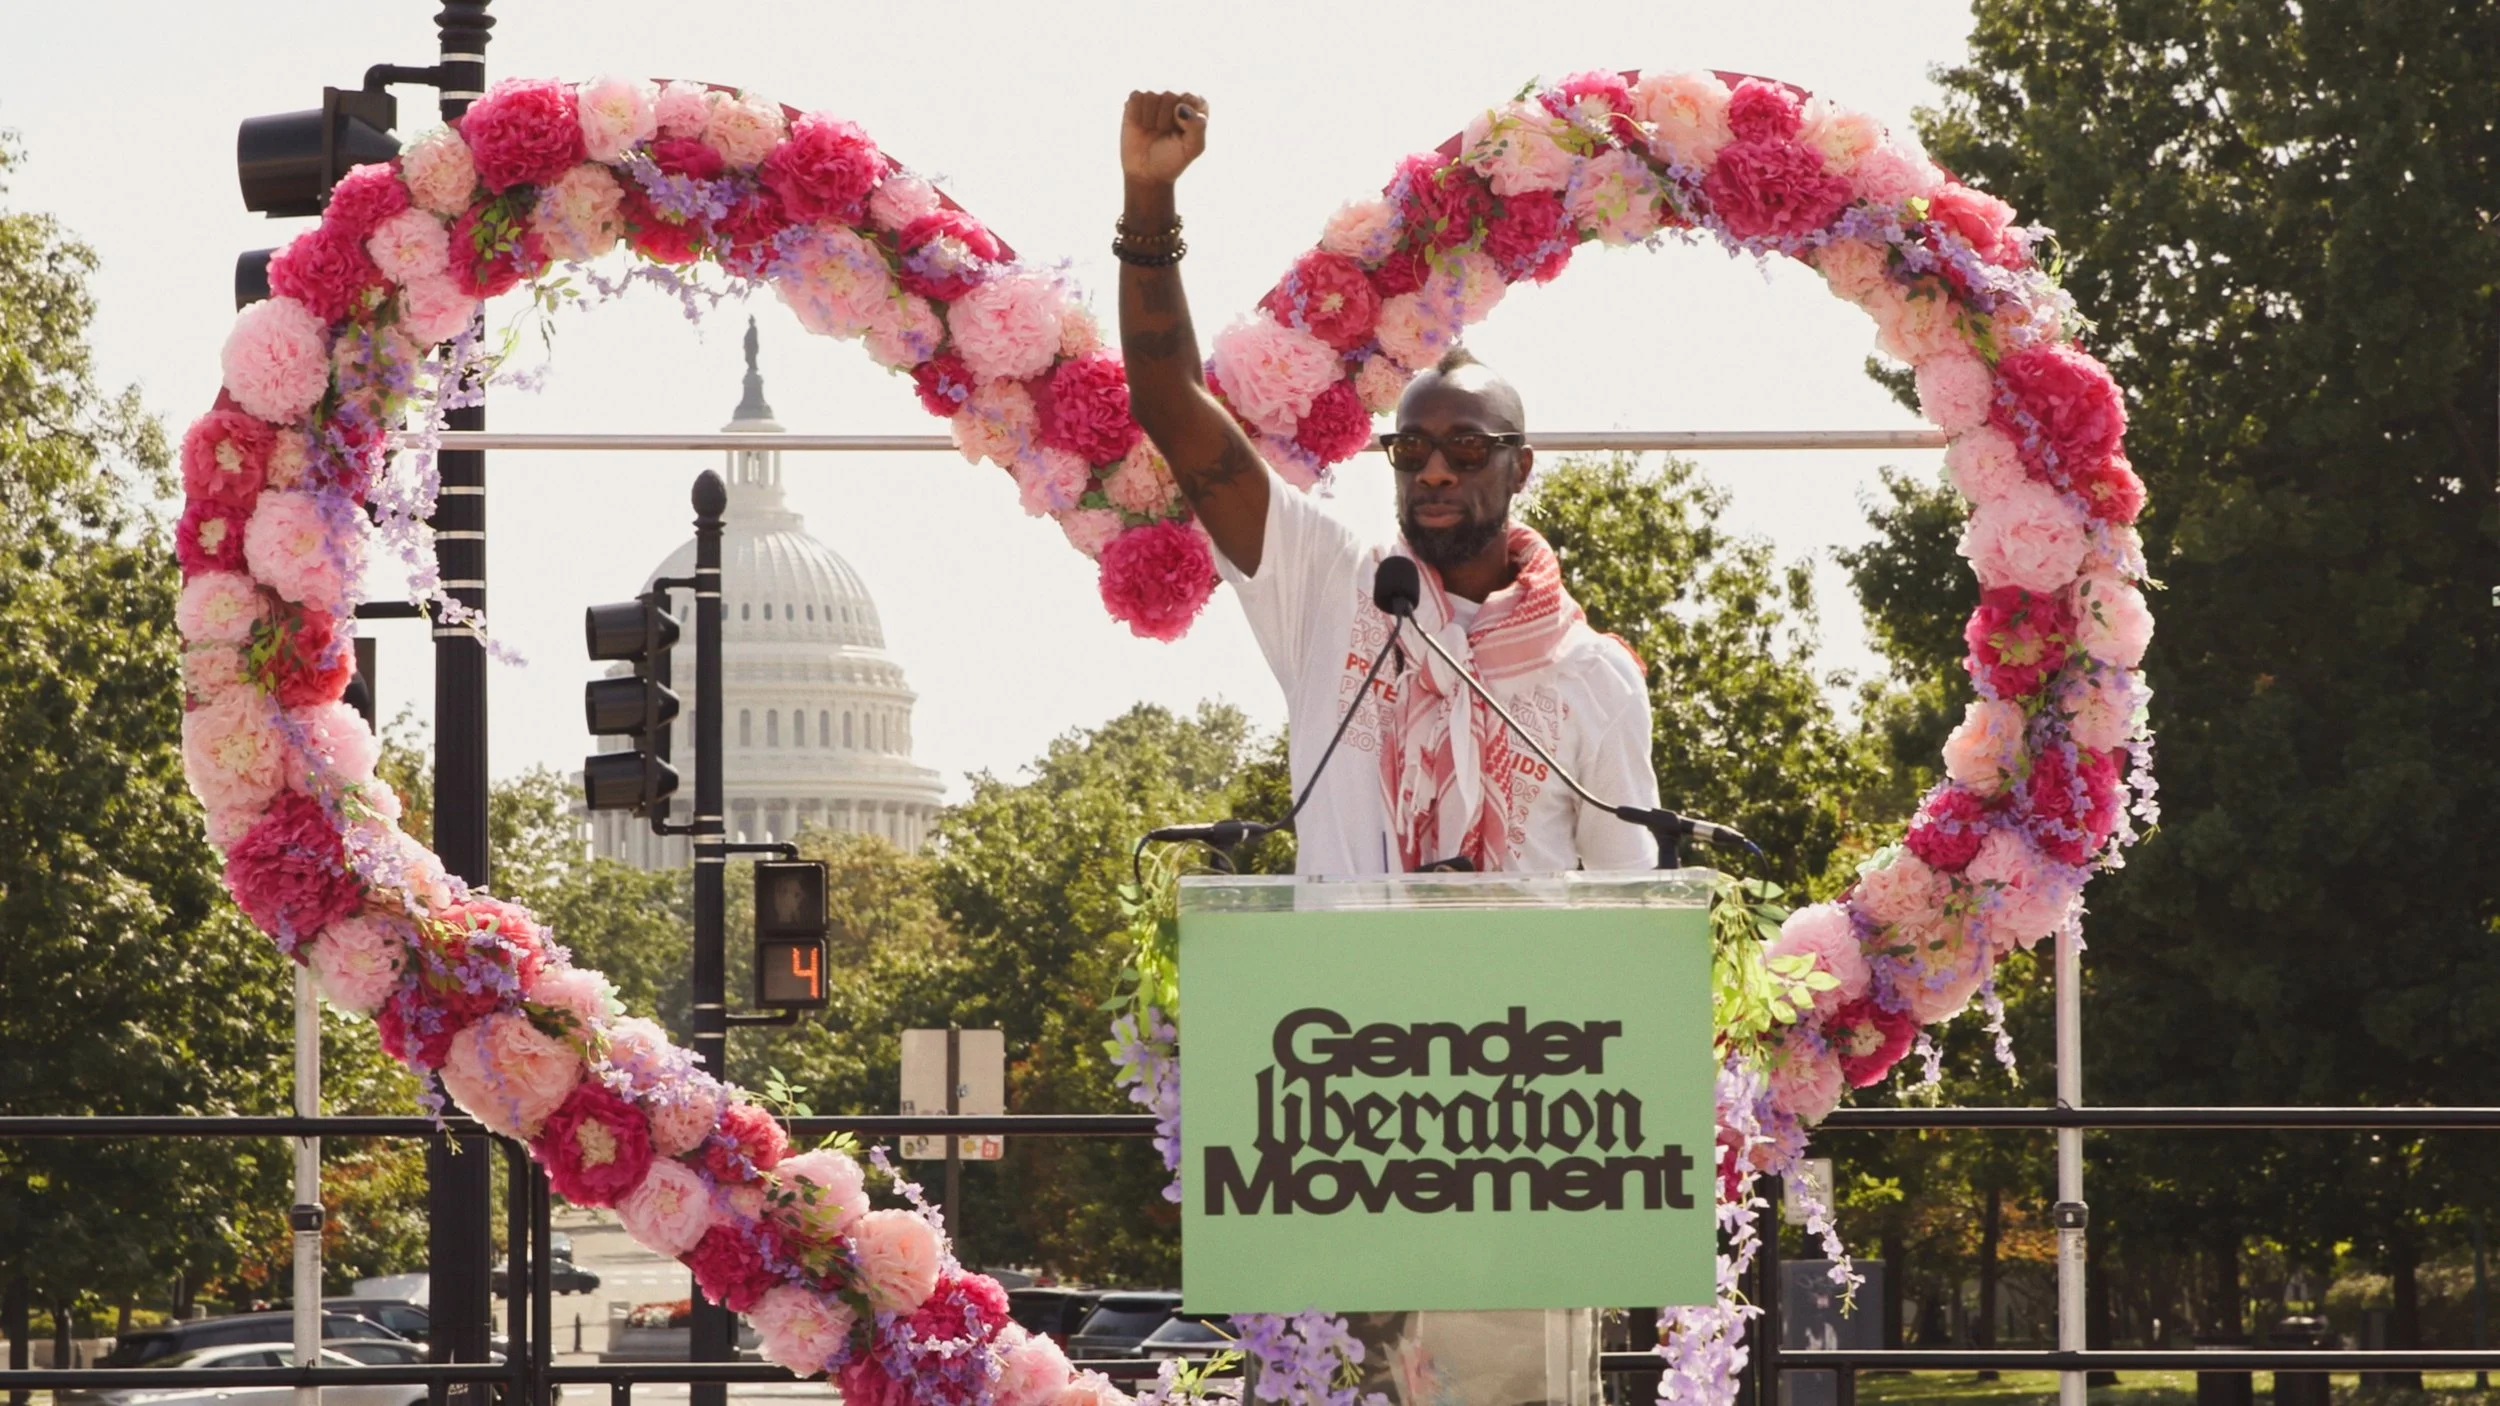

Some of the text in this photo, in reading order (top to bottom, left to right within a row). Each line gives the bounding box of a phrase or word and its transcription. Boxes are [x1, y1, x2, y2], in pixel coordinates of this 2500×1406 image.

[1510, 750, 1549, 782] IDS
[793, 947, 819, 999] 4
[1272, 1006, 1623, 1078] Gender
[1252, 1064, 1646, 1156] liberation
[1204, 1144, 1695, 1216] Movement
